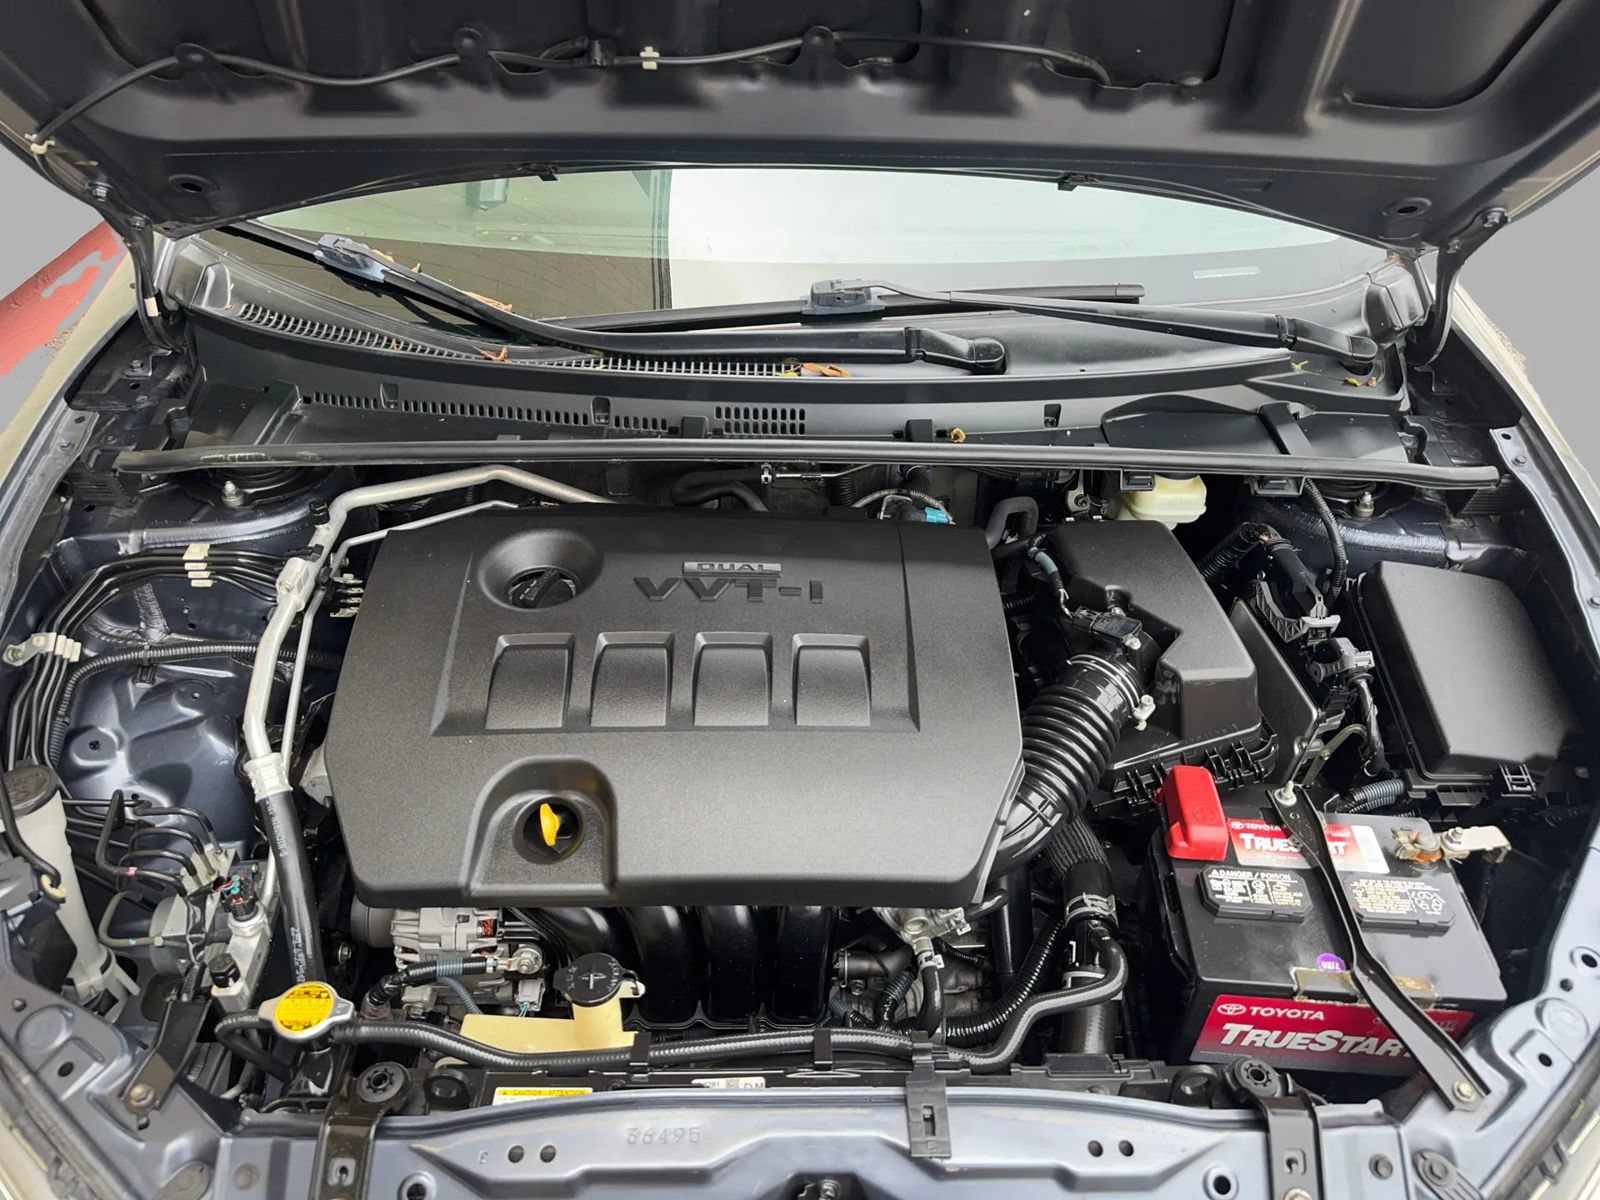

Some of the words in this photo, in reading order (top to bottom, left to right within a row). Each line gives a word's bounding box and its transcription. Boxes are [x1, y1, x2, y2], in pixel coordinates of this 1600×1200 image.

[697, 563, 779, 572] DUAL
[1245, 823, 1282, 832] TOYOTA
[1219, 869, 1253, 879] DANGER
[1261, 872, 1292, 881] POISON
[1250, 1006, 1325, 1021] TOYOTA
